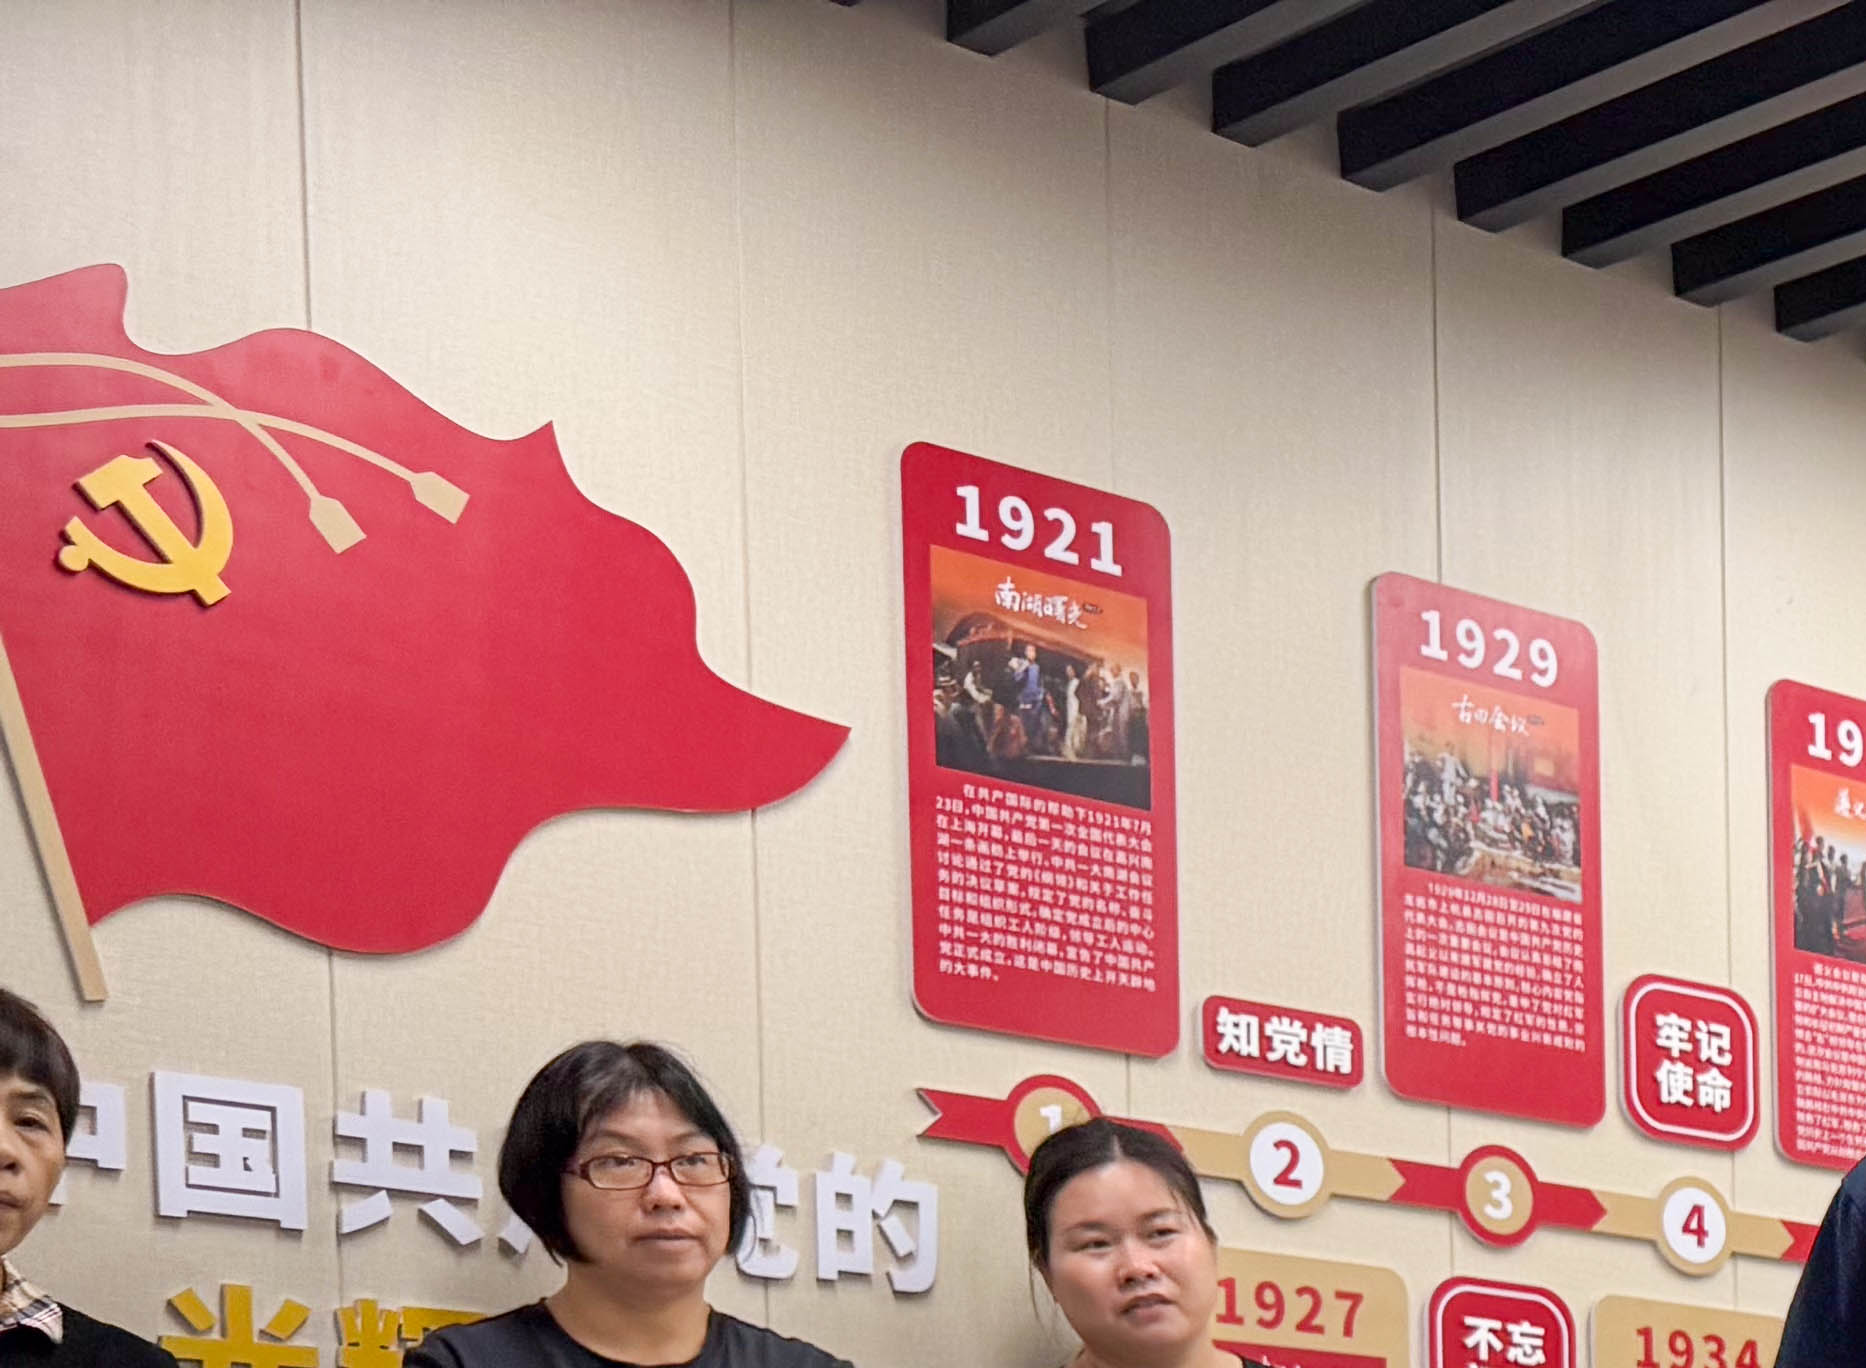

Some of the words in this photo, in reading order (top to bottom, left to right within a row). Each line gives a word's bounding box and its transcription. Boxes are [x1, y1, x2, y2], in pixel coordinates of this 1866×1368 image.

[956, 485, 1123, 577] 1921
[1420, 609, 1558, 688] 1929
[1216, 1006, 1354, 1074] 知党情
[1655, 1012, 1732, 1067] 牢记
[1655, 1059, 1732, 1113] 使命
[1040, 1104, 1062, 1135] 1
[48, 1070, 938, 1296] 国共的
[1273, 1139, 1303, 1189] 2
[1483, 1171, 1513, 1220] 3
[1682, 1204, 1710, 1249] 4
[1216, 1277, 1364, 1338] 1927
[1463, 1315, 1547, 1367] 不忘
